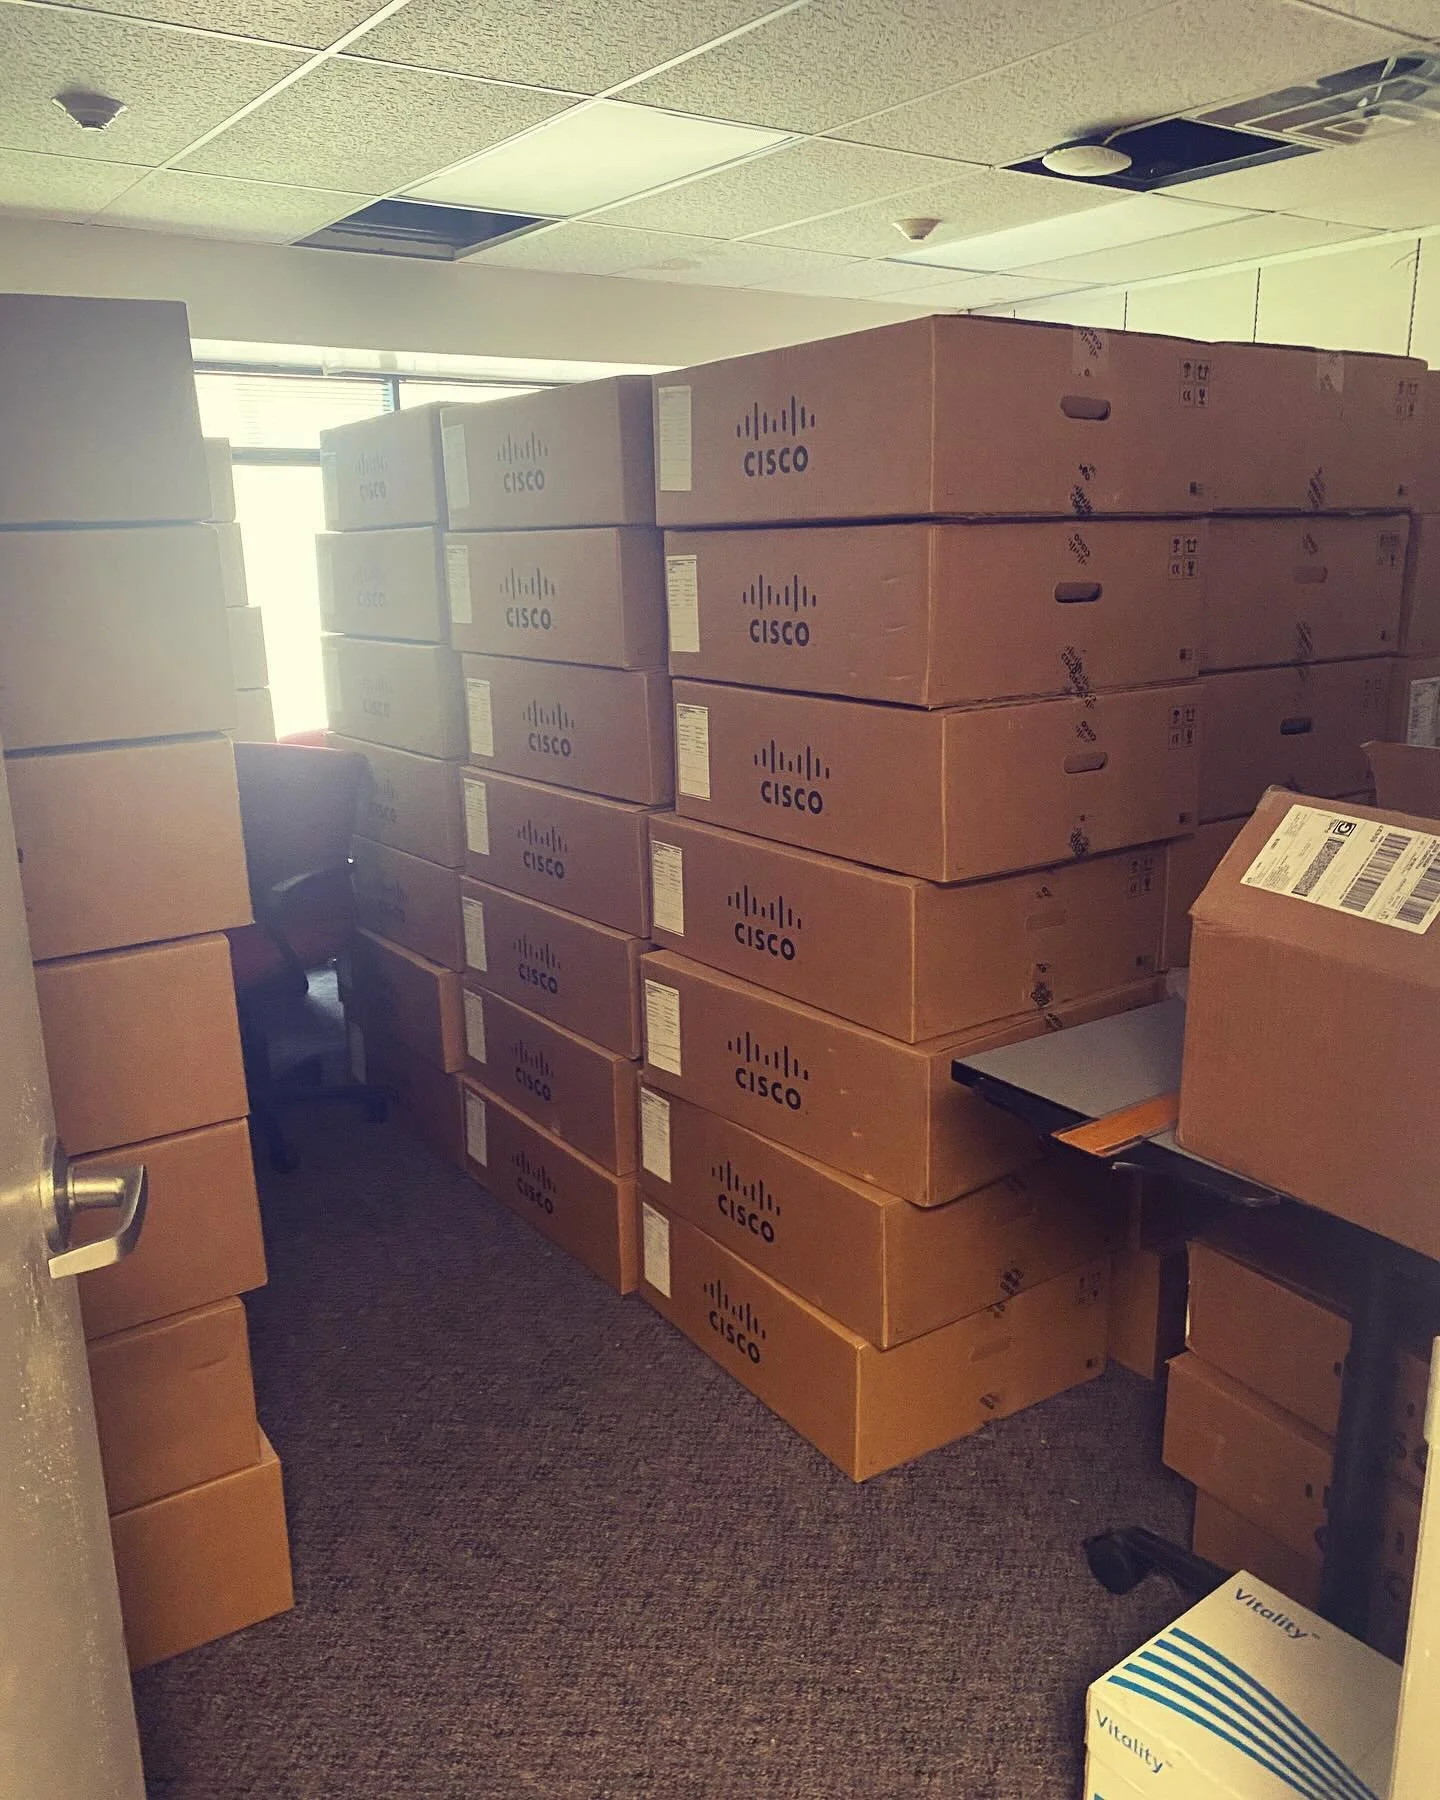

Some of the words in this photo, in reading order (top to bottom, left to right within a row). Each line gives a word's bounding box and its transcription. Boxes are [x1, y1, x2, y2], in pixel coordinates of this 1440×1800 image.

[744, 446, 809, 477] CISCO
[359, 481, 386, 500] CISCO
[503, 469, 545, 493] CISCO
[506, 608, 552, 630] CISCO
[749, 619, 810, 647] CISCO
[528, 732, 572, 758] CISCO
[761, 780, 823, 815] CISCO
[523, 850, 565, 880] CISCO
[735, 922, 796, 961] CISCO
[518, 962, 558, 995] CISCO
[515, 1067, 552, 1101] CISCO
[735, 1067, 802, 1110] CISCO
[516, 1178, 554, 1215] CISCO
[718, 1193, 775, 1243] CISCO
[709, 1310, 761, 1364] CISCO
[1235, 1588, 1308, 1640] Vitality
[1096, 1709, 1163, 1774] Vitality
